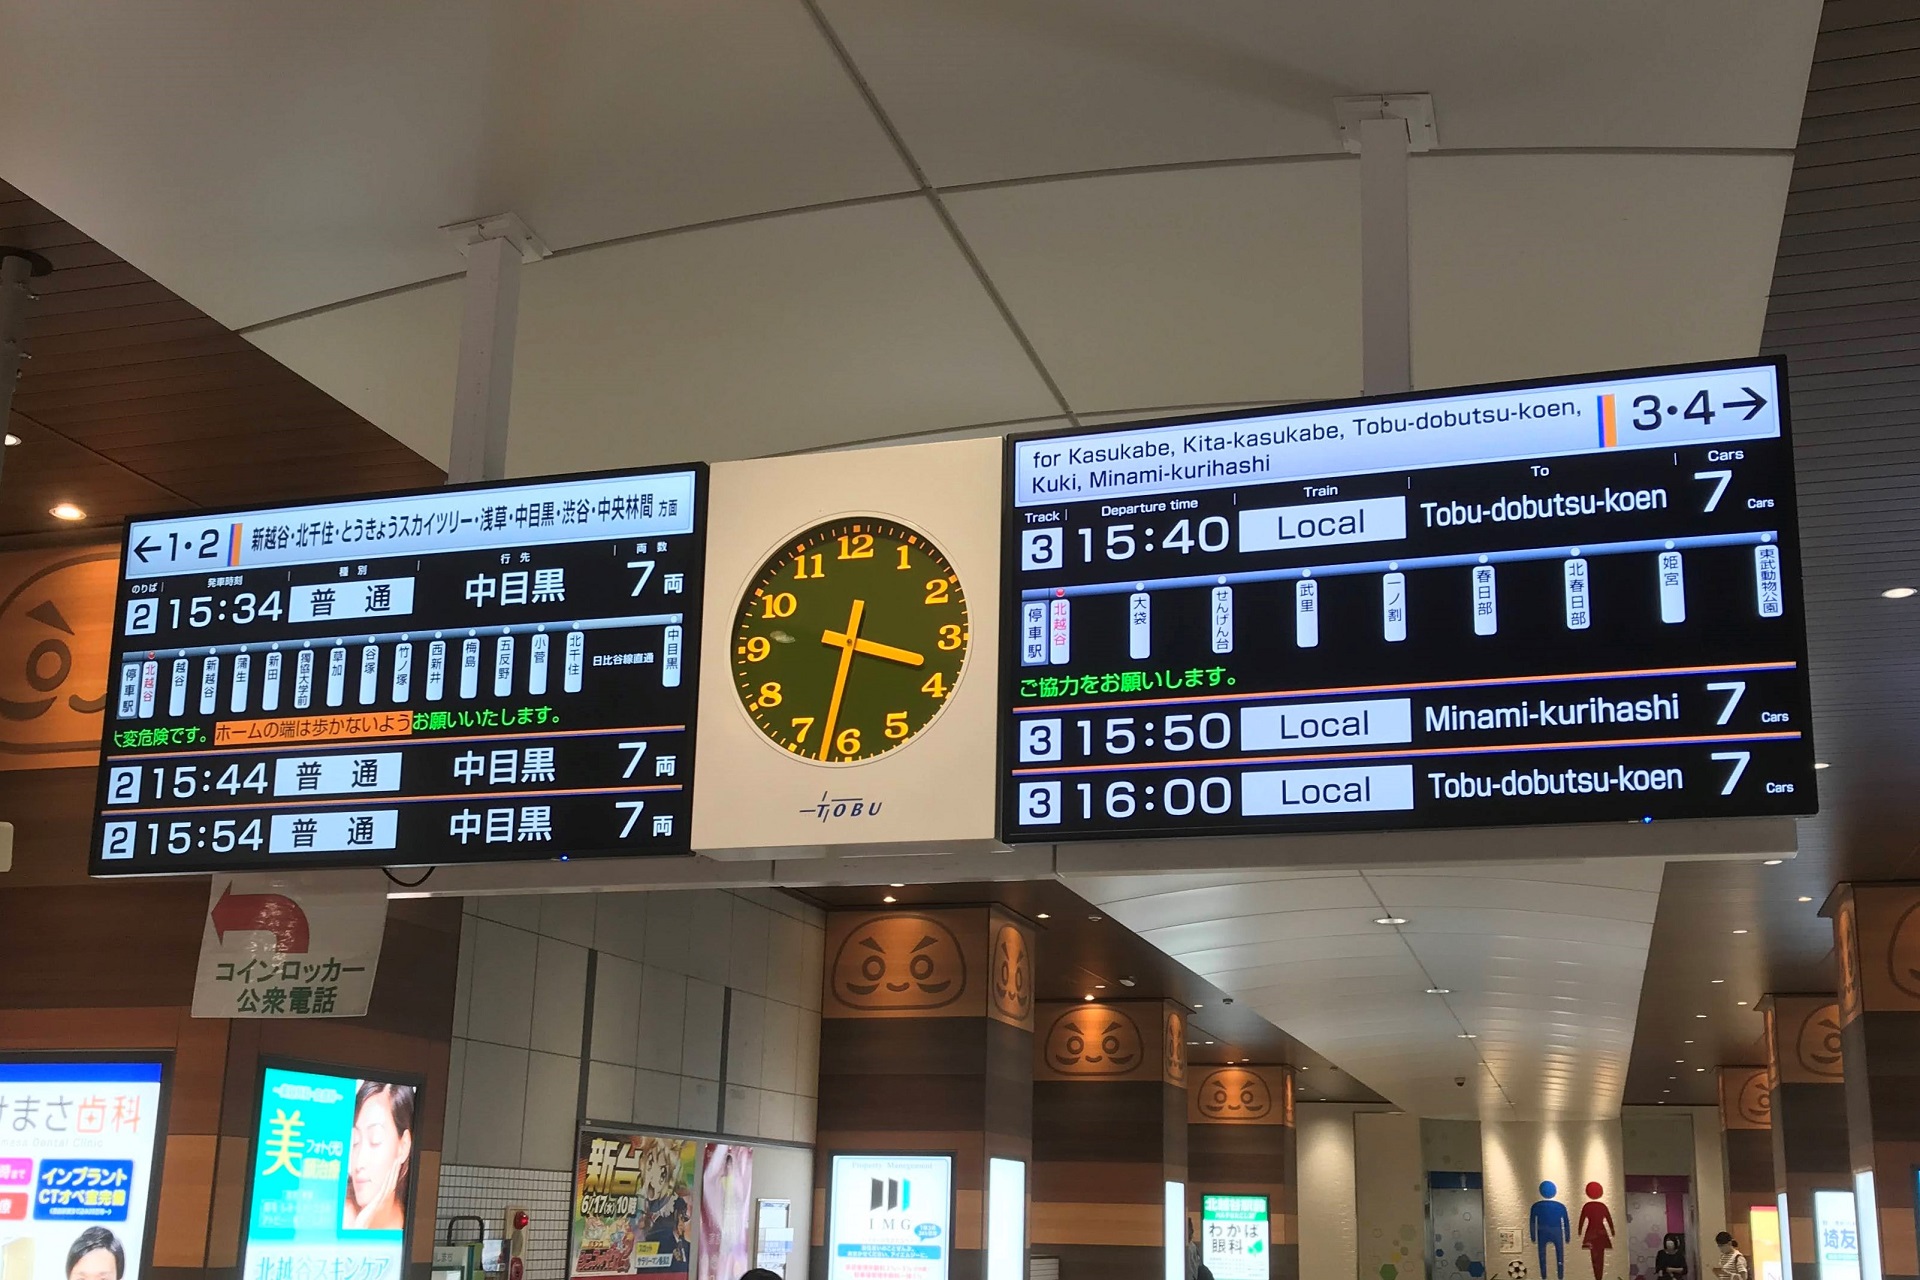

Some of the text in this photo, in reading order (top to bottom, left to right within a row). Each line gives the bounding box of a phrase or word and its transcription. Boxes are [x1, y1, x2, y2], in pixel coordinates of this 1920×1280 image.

[1033, 399, 1582, 468] for Kasukabe, Kita-kasukabe, Tobu-dobutsu-koen,
[1707, 449, 1744, 463] Cars
[1032, 455, 1271, 494] Kuki, Minami-kurihashi
[1531, 465, 1550, 477] To
[1303, 484, 1338, 498] Train
[658, 499, 678, 518] 方面
[1025, 509, 1060, 523] Track
[1031, 469, 1774, 564] 3 15:40 Local Tobu-dobutsu-koen 7 Cars
[1101, 497, 1198, 518] Departure time
[500, 552, 531, 565] 行先
[636, 541, 668, 554] 両数
[837, 534, 874, 560] 12
[897, 545, 912, 569] 1
[338, 565, 368, 577] 種別
[793, 553, 825, 580] 11
[1663, 555, 1680, 586] 姫宮
[131, 582, 158, 594] のりば
[207, 575, 243, 587] 発車時刻
[924, 579, 950, 605] 2
[1477, 569, 1493, 615] 春日部
[1569, 562, 1586, 625] 北春日部
[1760, 548, 1778, 614] 東武動物公園
[132, 560, 684, 630] 2 15:34 普通 中目黒 7 両
[762, 593, 797, 619] 10
[1300, 583, 1315, 612] 武里
[1053, 603, 1067, 646] 北越谷
[1133, 597, 1147, 625] 大袋
[1215, 590, 1229, 651] せんげん台
[937, 624, 962, 650] 3
[1028, 608, 1043, 659] 停車駅
[363, 648, 377, 674] 谷塚
[464, 641, 477, 668] 梅島
[498, 639, 512, 680] 五反野
[533, 637, 546, 664] 小菅
[568, 635, 581, 676] 北千住
[592, 652, 654, 667] 日比谷線直通
[666, 629, 680, 670] 中目黒
[747, 637, 771, 662] 9
[174, 662, 186, 687] 越谷
[267, 654, 279, 680] 新田
[331, 650, 344, 677] 草加
[430, 643, 444, 684] 西新井
[123, 669, 137, 713] 停車駅
[143, 664, 155, 702] 北越谷
[203, 659, 217, 698] 新越谷
[922, 672, 947, 698] 4
[1020, 666, 1236, 698] ご協力をお願いします。
[758, 682, 783, 707] 8
[792, 717, 814, 743] 7
[884, 711, 909, 738] 5
[1029, 681, 1789, 756] 3 15:50 Local Minami-kurihashi 7 Cars
[837, 729, 861, 755] 6
[115, 741, 676, 799] 2 15:44 普通 中目黒 7 両
[1029, 751, 1794, 820] 3 16:00 Local Tobu-dobutsu-koen 7 Cars
[812, 797, 882, 820] TOBU
[110, 801, 673, 855] 2 15:54 普通 中目黒 7 両
[215, 957, 365, 984] コインロッカー
[236, 986, 338, 1014] 公衆電話
[262, 1108, 306, 1177] 美
[41, 1167, 128, 1187] インプラント
[584, 1137, 643, 1196] 新台
[1209, 1223, 1259, 1238] わかば
[1212, 1239, 1243, 1254] 眼科
